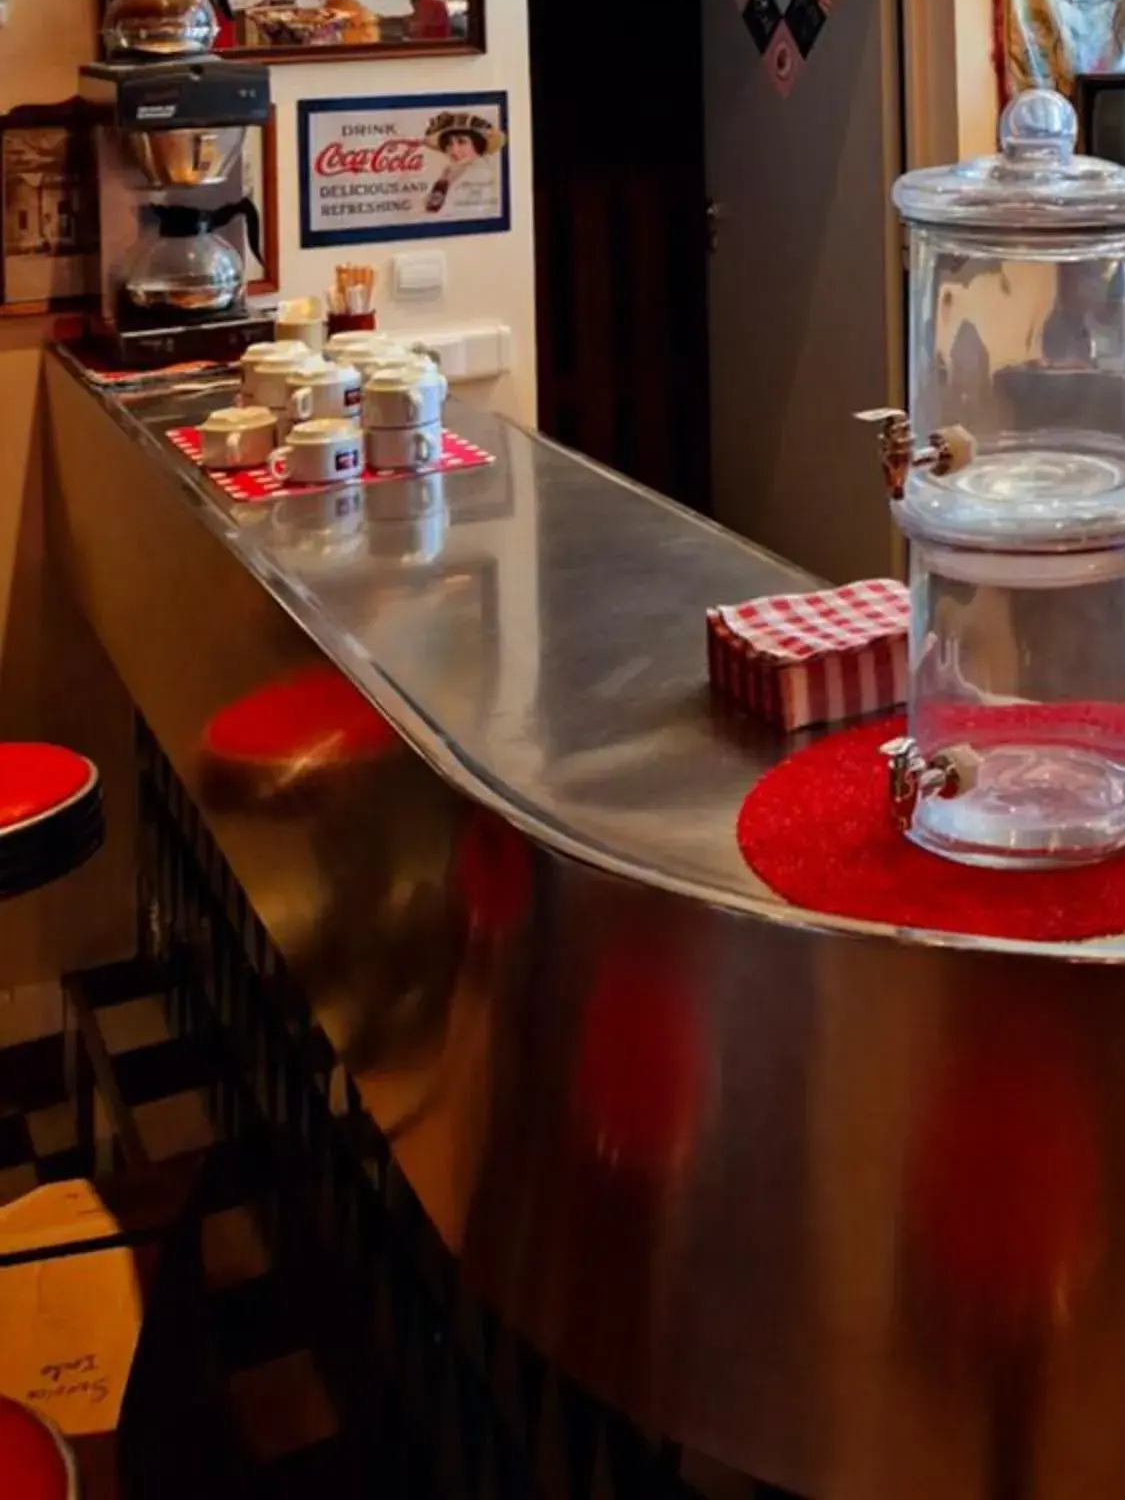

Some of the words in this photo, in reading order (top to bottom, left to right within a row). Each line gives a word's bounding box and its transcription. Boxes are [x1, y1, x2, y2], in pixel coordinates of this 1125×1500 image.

[341, 123, 398, 138] DRINK
[314, 138, 425, 177] Coca-Cola
[319, 182, 399, 199] DELICIOUS
[402, 182, 428, 193] AND
[320, 198, 413, 217] REFRESHING
